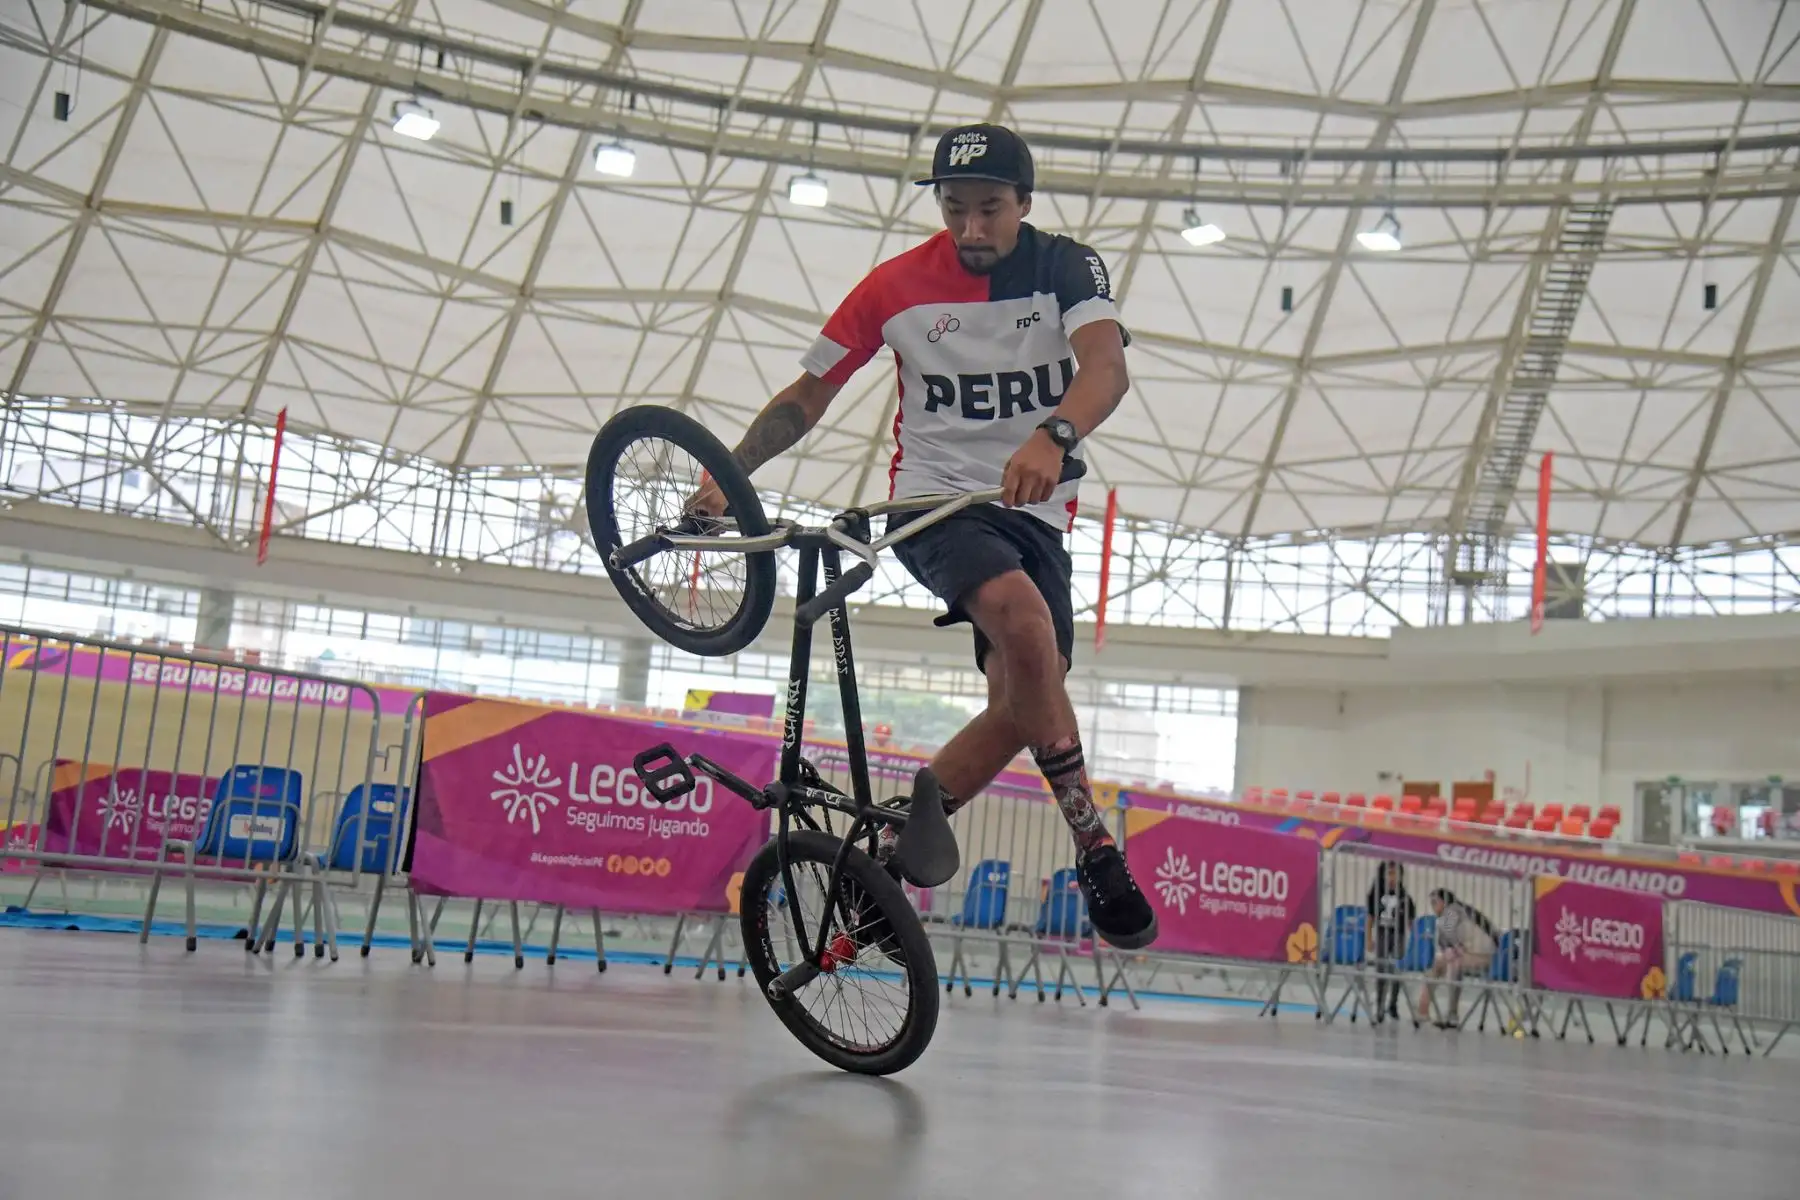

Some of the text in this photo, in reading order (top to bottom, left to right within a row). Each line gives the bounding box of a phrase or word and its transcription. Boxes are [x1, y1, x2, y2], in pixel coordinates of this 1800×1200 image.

[949, 144, 988, 167] WP
[1016, 311, 1041, 329] FDC
[921, 357, 1074, 420] PERU
[131, 661, 348, 702] SEGUIMOS JUGANDO
[566, 806, 645, 833] Seguimos
[1437, 843, 1686, 896] SEGUIMOS JUGANDO
